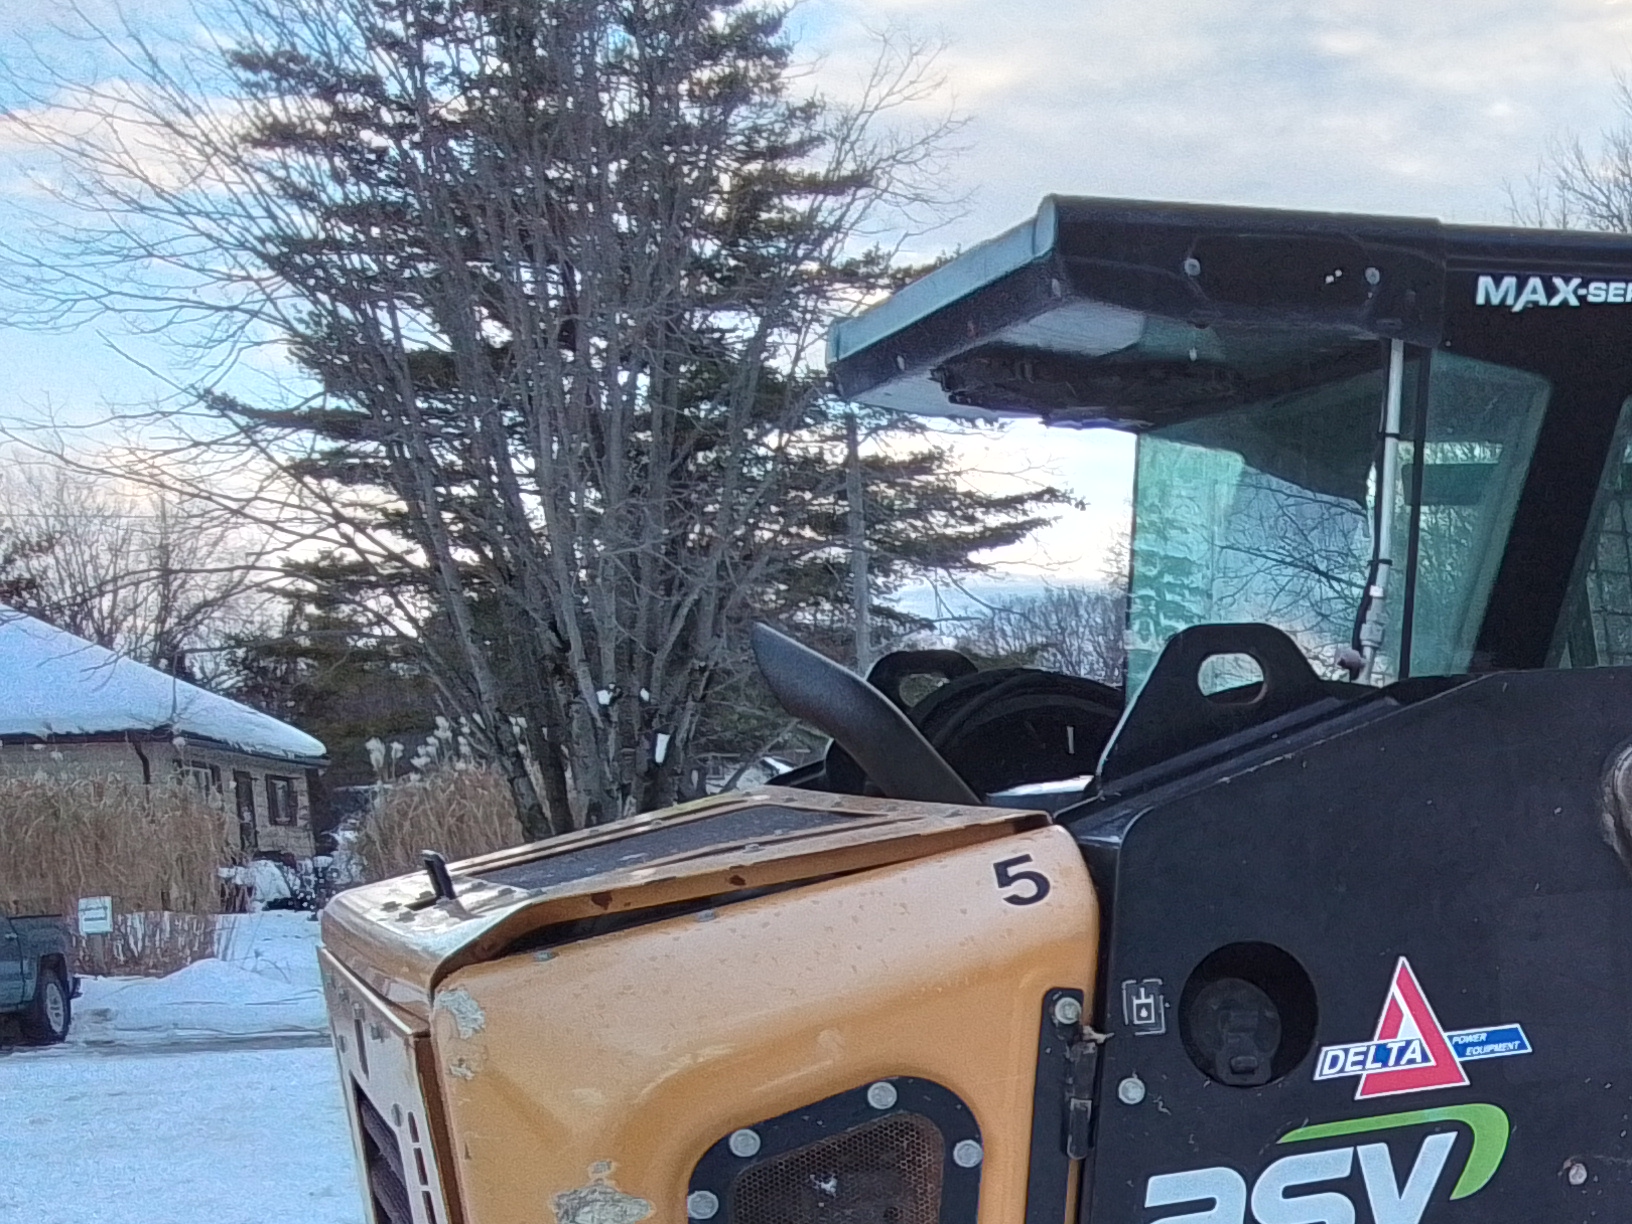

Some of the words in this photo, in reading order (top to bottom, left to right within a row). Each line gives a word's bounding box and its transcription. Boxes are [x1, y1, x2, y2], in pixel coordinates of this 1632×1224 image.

[993, 854, 1050, 905] 5
[1452, 1032, 1488, 1045] POWER
[1465, 1040, 1521, 1056] EQUIPMENT
[1322, 1039, 1423, 1075] DELTA
